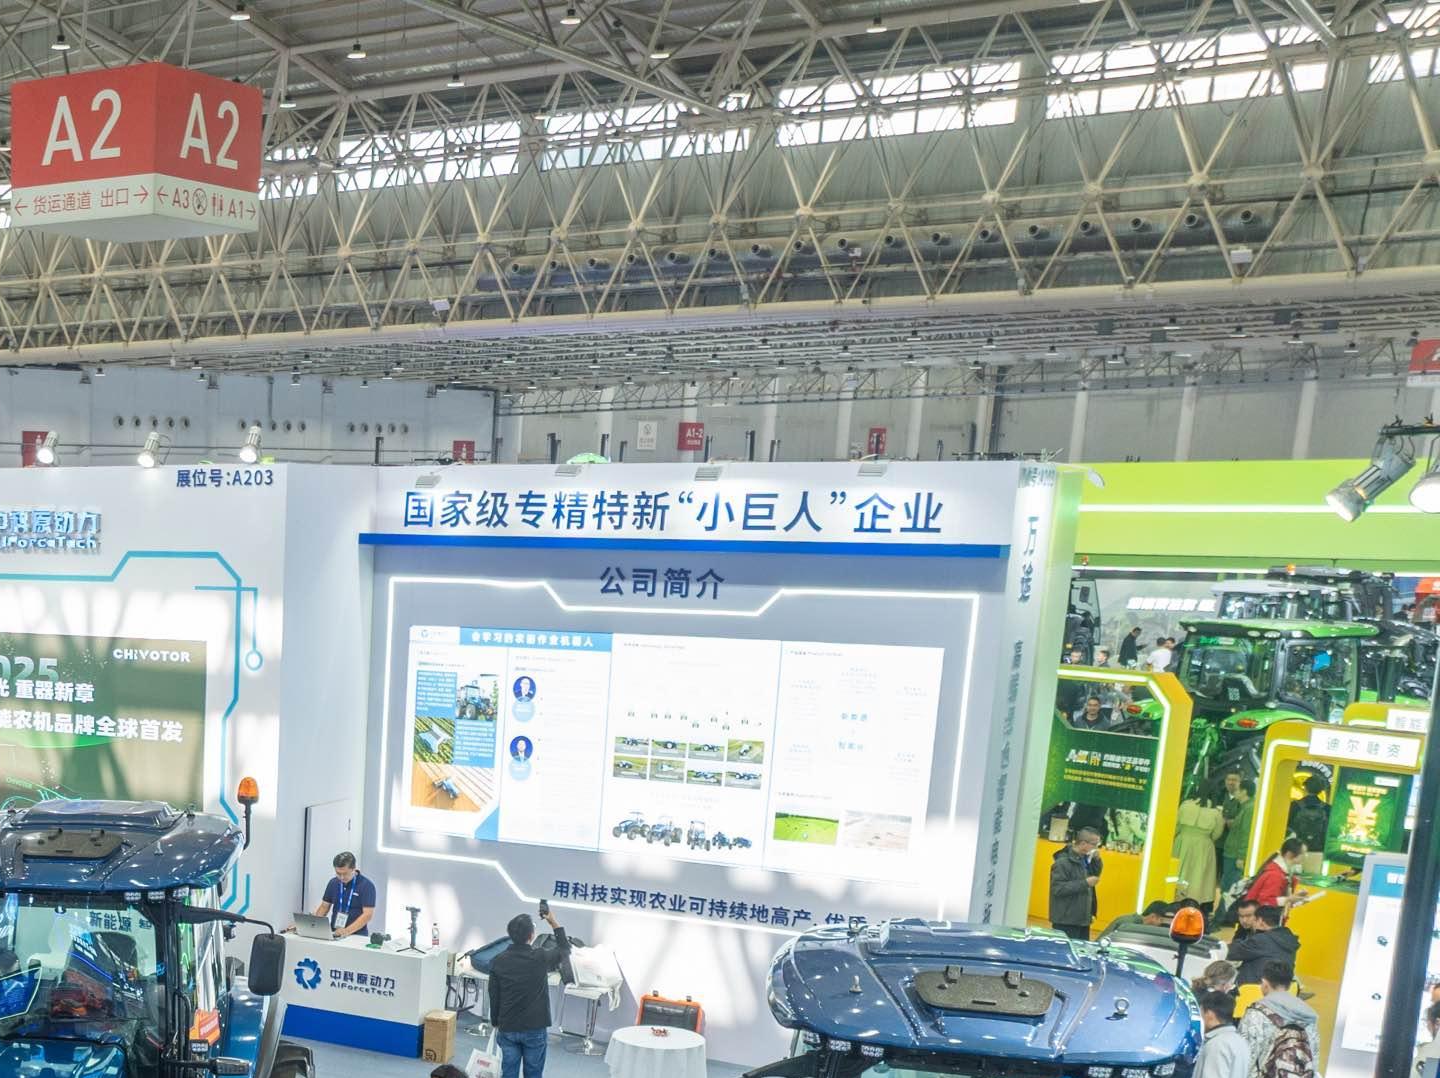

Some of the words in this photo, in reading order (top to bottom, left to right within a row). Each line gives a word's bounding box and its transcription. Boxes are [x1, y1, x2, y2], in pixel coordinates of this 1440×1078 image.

[41, 89, 121, 166] A2
[179, 93, 239, 170] A2
[33, 191, 92, 214] 货运通道
[100, 187, 130, 207] 出口
[172, 188, 190, 209] A3
[228, 200, 244, 219] A1
[176, 468, 274, 489] 展位号:A203
[403, 490, 944, 535] 国家级专精特新“小巨人”企业
[599, 566, 725, 600] 公司简介
[15, 677, 95, 703] 重器新章
[89, 910, 133, 932] 新能源
[330, 969, 395, 989] 中科原动力
[330, 981, 395, 997] AIForceTech
